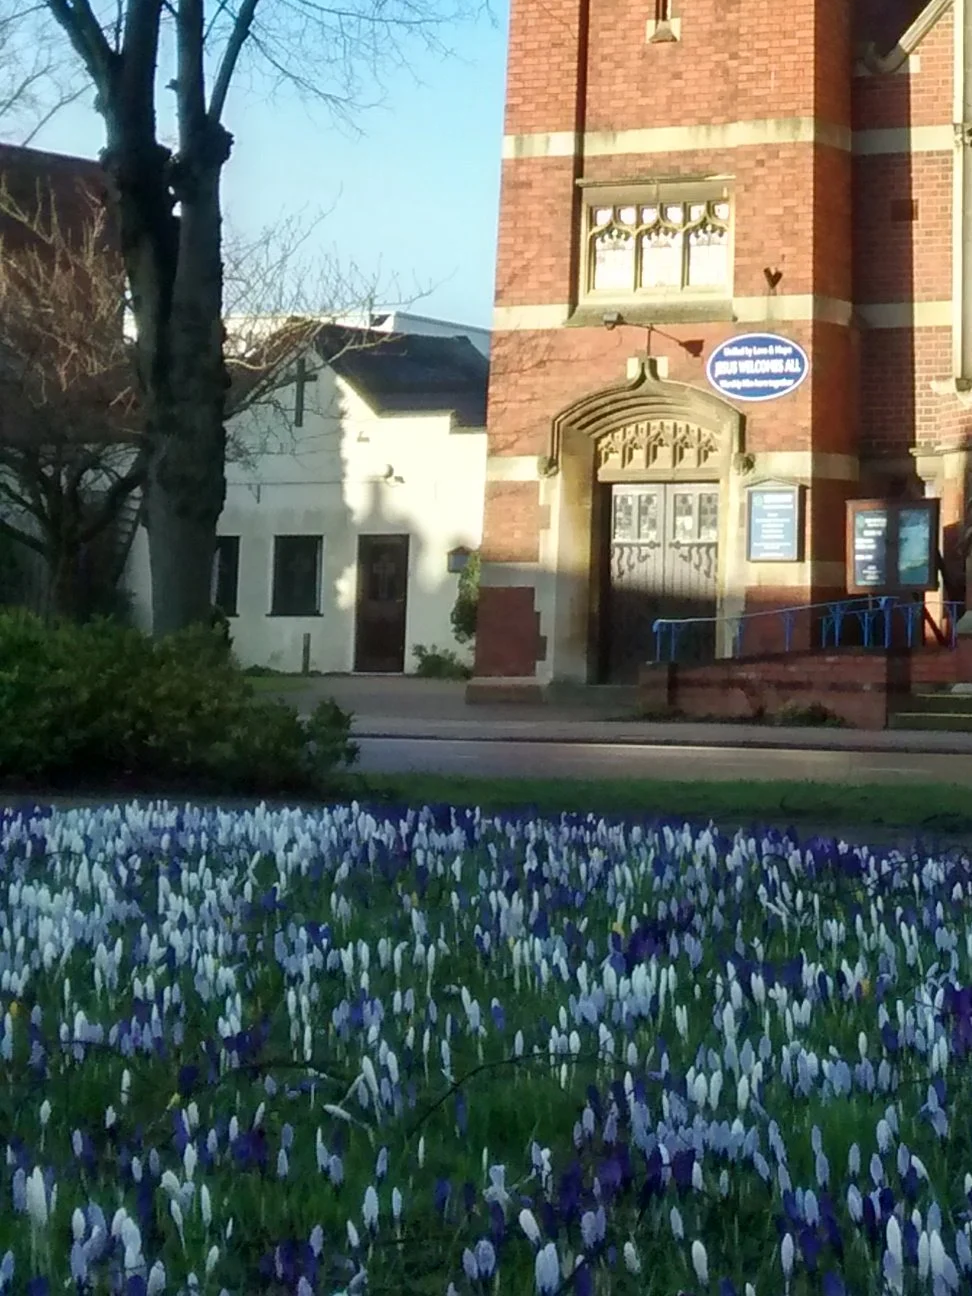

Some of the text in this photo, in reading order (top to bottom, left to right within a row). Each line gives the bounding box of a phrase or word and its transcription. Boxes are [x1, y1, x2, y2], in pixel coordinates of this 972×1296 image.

[714, 358, 801, 377] JESUS WELCOMES ALL
